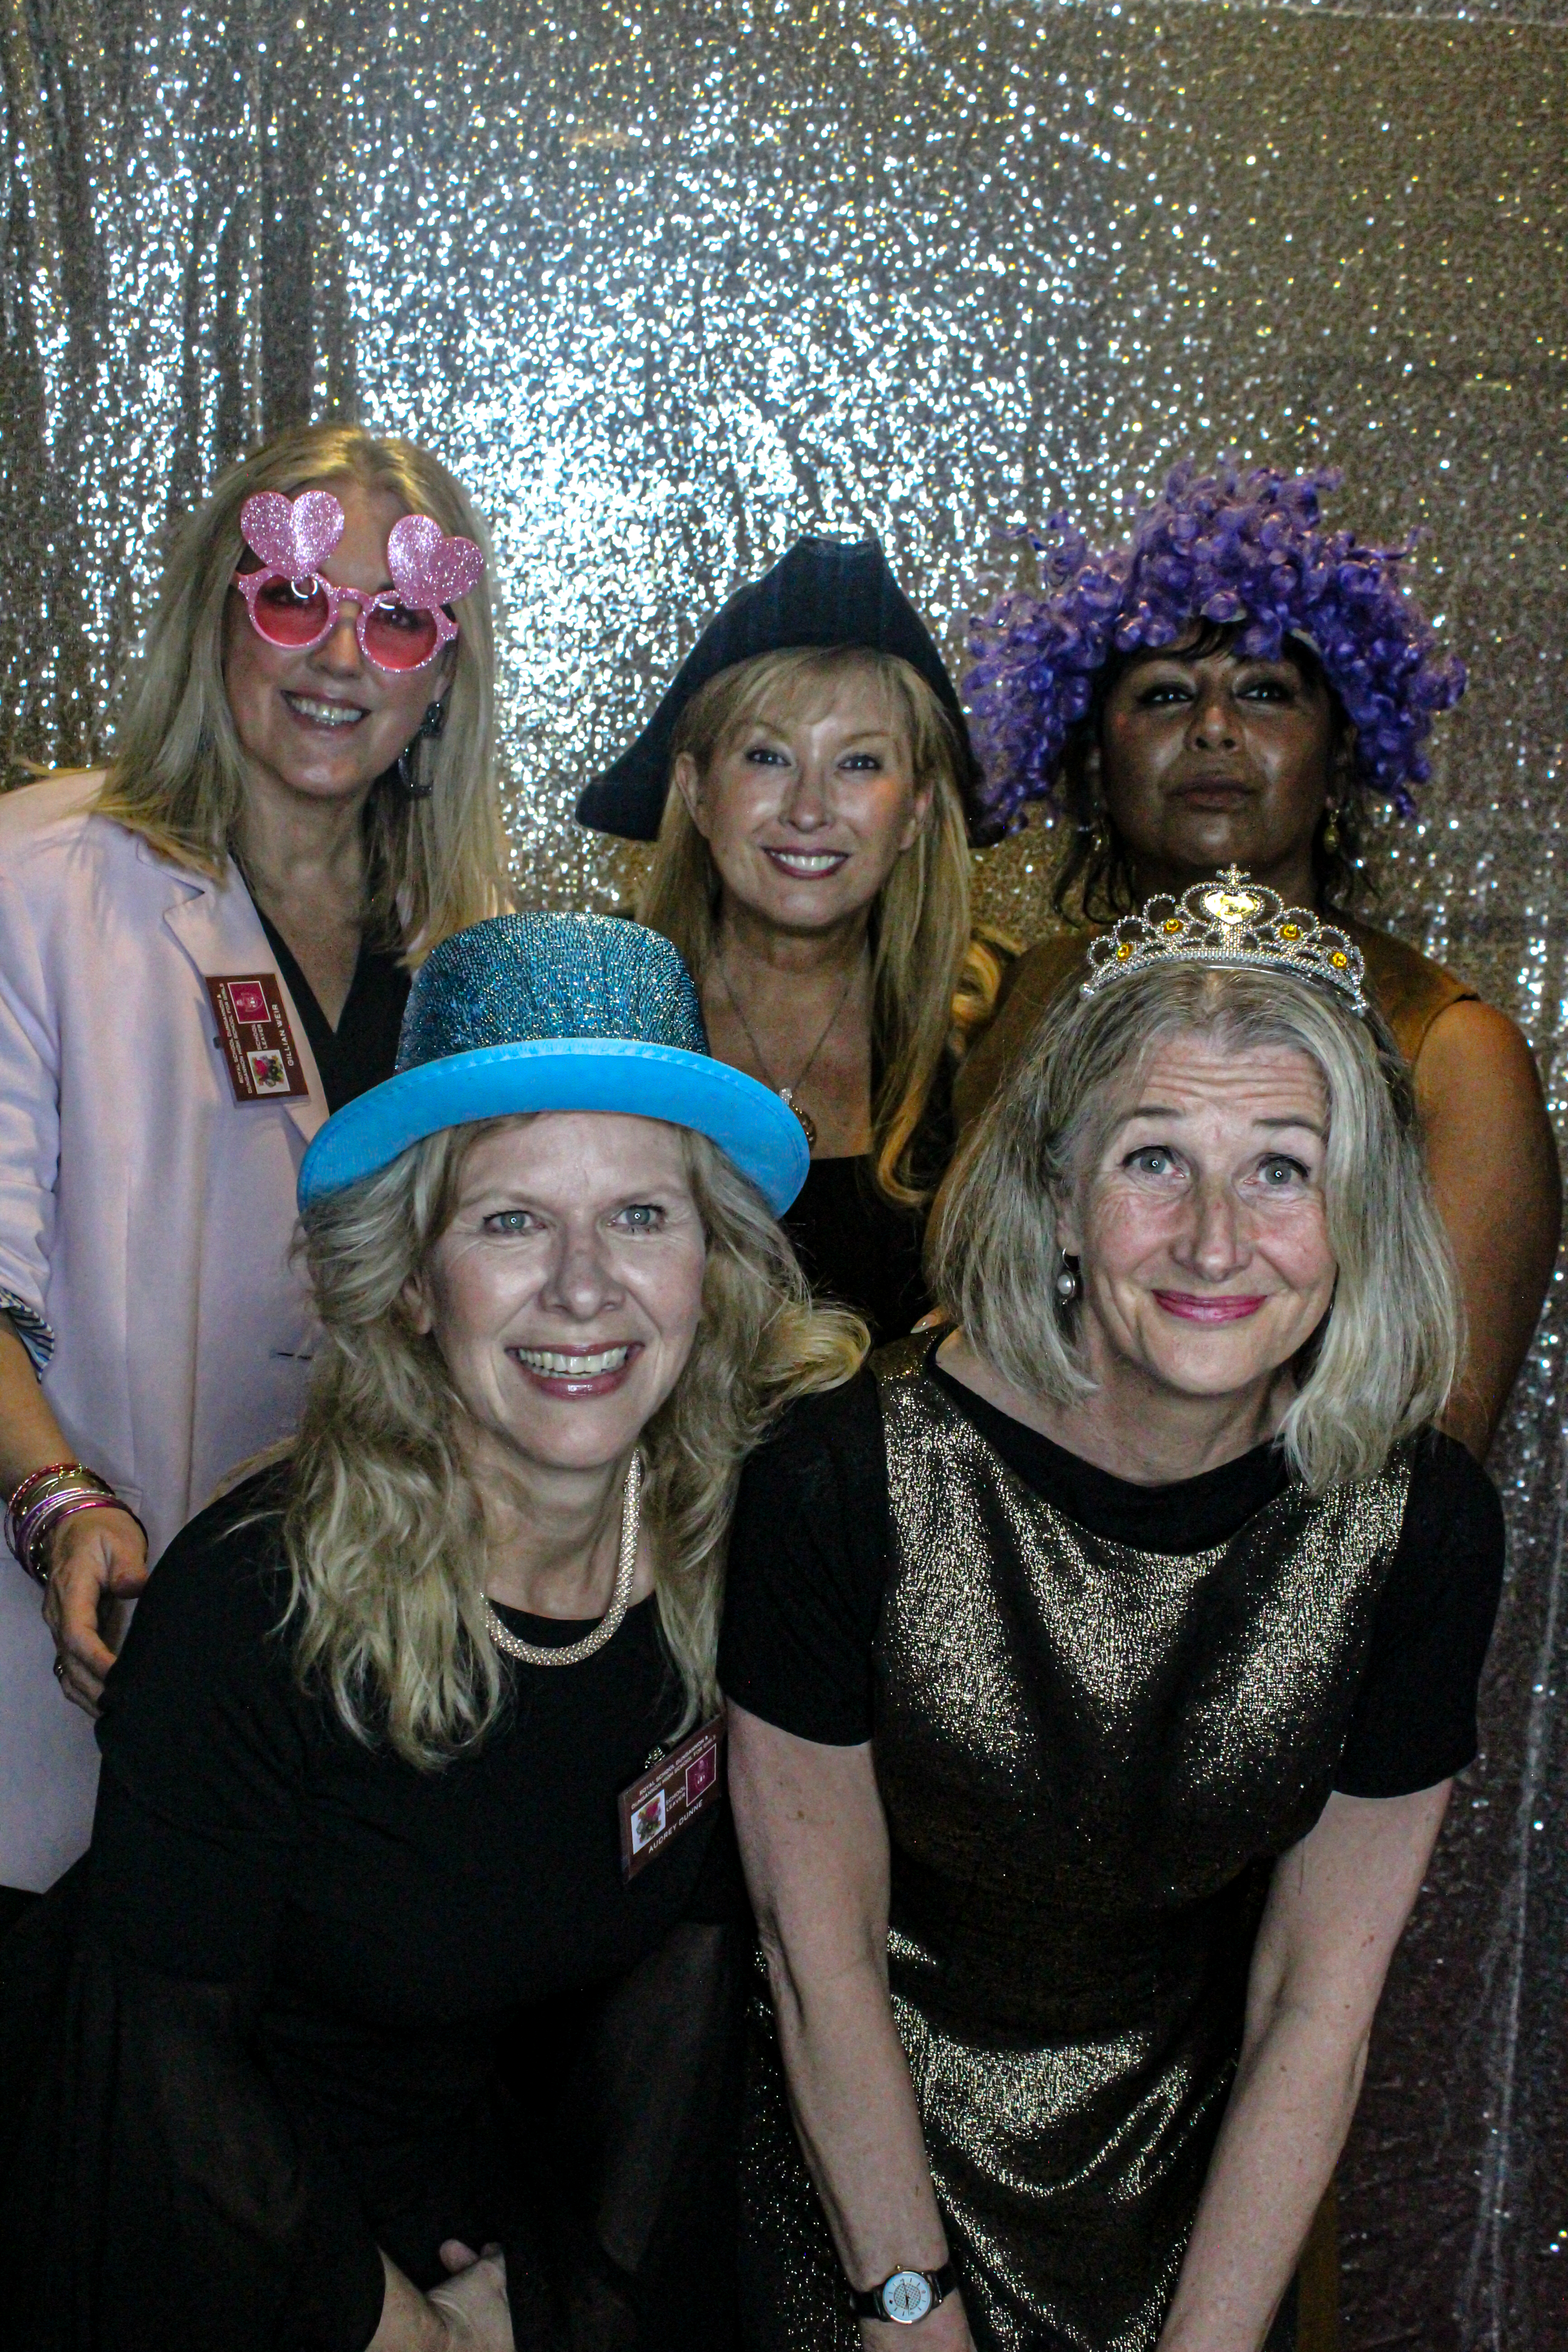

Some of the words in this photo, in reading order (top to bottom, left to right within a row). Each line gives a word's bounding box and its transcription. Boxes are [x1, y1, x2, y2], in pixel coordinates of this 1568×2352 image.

[272, 1004, 282, 1028] WEIR
[251, 1024, 262, 1050] SCHOOL
[257, 1024, 268, 1049] LEAVER
[279, 1029, 294, 1066] GILLIAN
[666, 1792, 686, 1812] LEAVER
[649, 1823, 677, 1854] AUDREY
[679, 1799, 703, 1826] DUNNE
